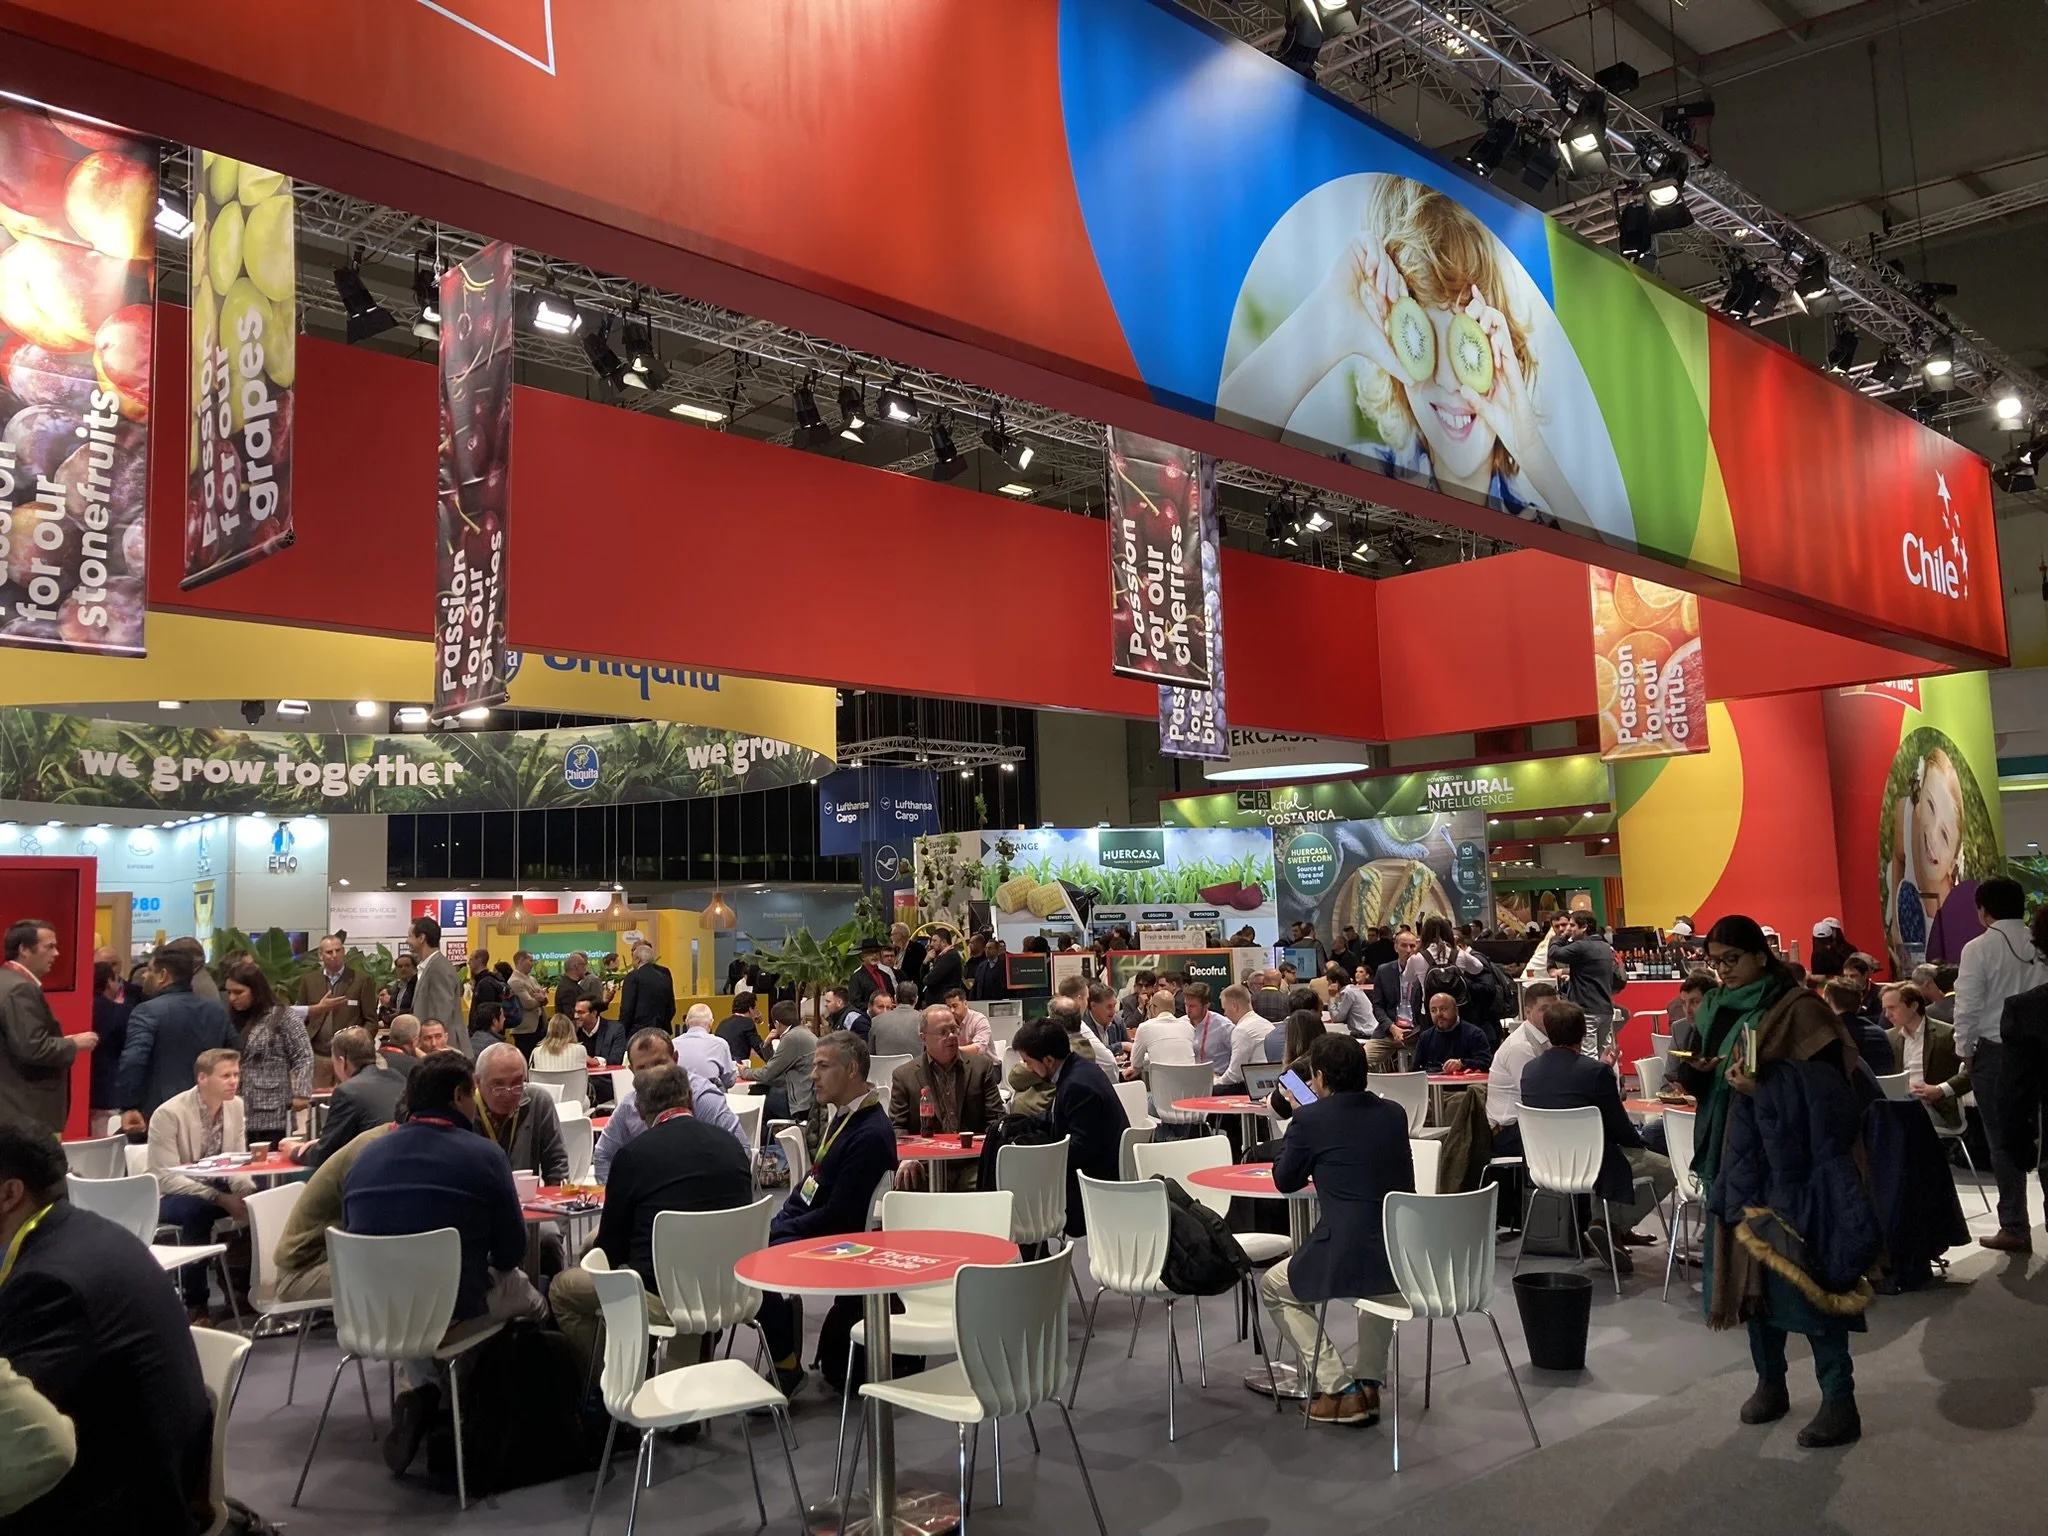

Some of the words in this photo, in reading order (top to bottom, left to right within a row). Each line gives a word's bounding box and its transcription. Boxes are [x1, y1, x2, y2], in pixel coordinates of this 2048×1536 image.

[216, 346, 232, 439] our
[237, 306, 279, 521] grapes
[197, 324, 218, 547] Passion
[33, 475, 67, 551] our
[72, 389, 120, 627] stonefruits
[220, 452, 241, 536] for
[1146, 545, 1165, 607] our
[1902, 532, 1960, 599] Chile
[16, 558, 61, 621] for
[469, 567, 484, 628] our
[481, 530, 502, 682] cherries
[1121, 518, 1147, 657] Passion
[1165, 523, 1191, 666] cherries
[441, 549, 467, 691] Passion
[1149, 610, 1168, 662] for
[462, 635, 482, 688] for
[1641, 658, 1659, 700] our
[1169, 686, 1186, 741] Pass
[1612, 644, 1638, 744] Passion
[1663, 664, 1690, 739] citrus
[1187, 706, 1201, 743] for
[1642, 704, 1663, 742] for
[79, 750, 141, 779] we
[151, 755, 266, 792] grow
[273, 753, 464, 797] together
[565, 768, 599, 783] Chiquita
[686, 743, 727, 770] we
[733, 736, 791, 775] grow
[1426, 775, 1454, 783] POWERED
[1427, 777, 1515, 799] NATURAL
[836, 801, 870, 812] Lufthansa
[836, 813, 858, 824] Cargo
[895, 800, 933, 811] Lufthansa
[895, 810, 919, 822] Cargo
[1306, 809, 1336, 822] RICA
[1428, 793, 1514, 811] INTELLIGENCE
[1102, 849, 1160, 861] HUERCASA
[1288, 856, 1310, 864] SWEET
[1312, 854, 1332, 862] CORN
[1291, 847, 1328, 856] HUERCASA
[1302, 878, 1320, 886] health
[131, 896, 160, 912] 980
[1190, 965, 1226, 976] Decofrut
[868, 1258, 921, 1270] Chile
[874, 1251, 941, 1265] Frutas
